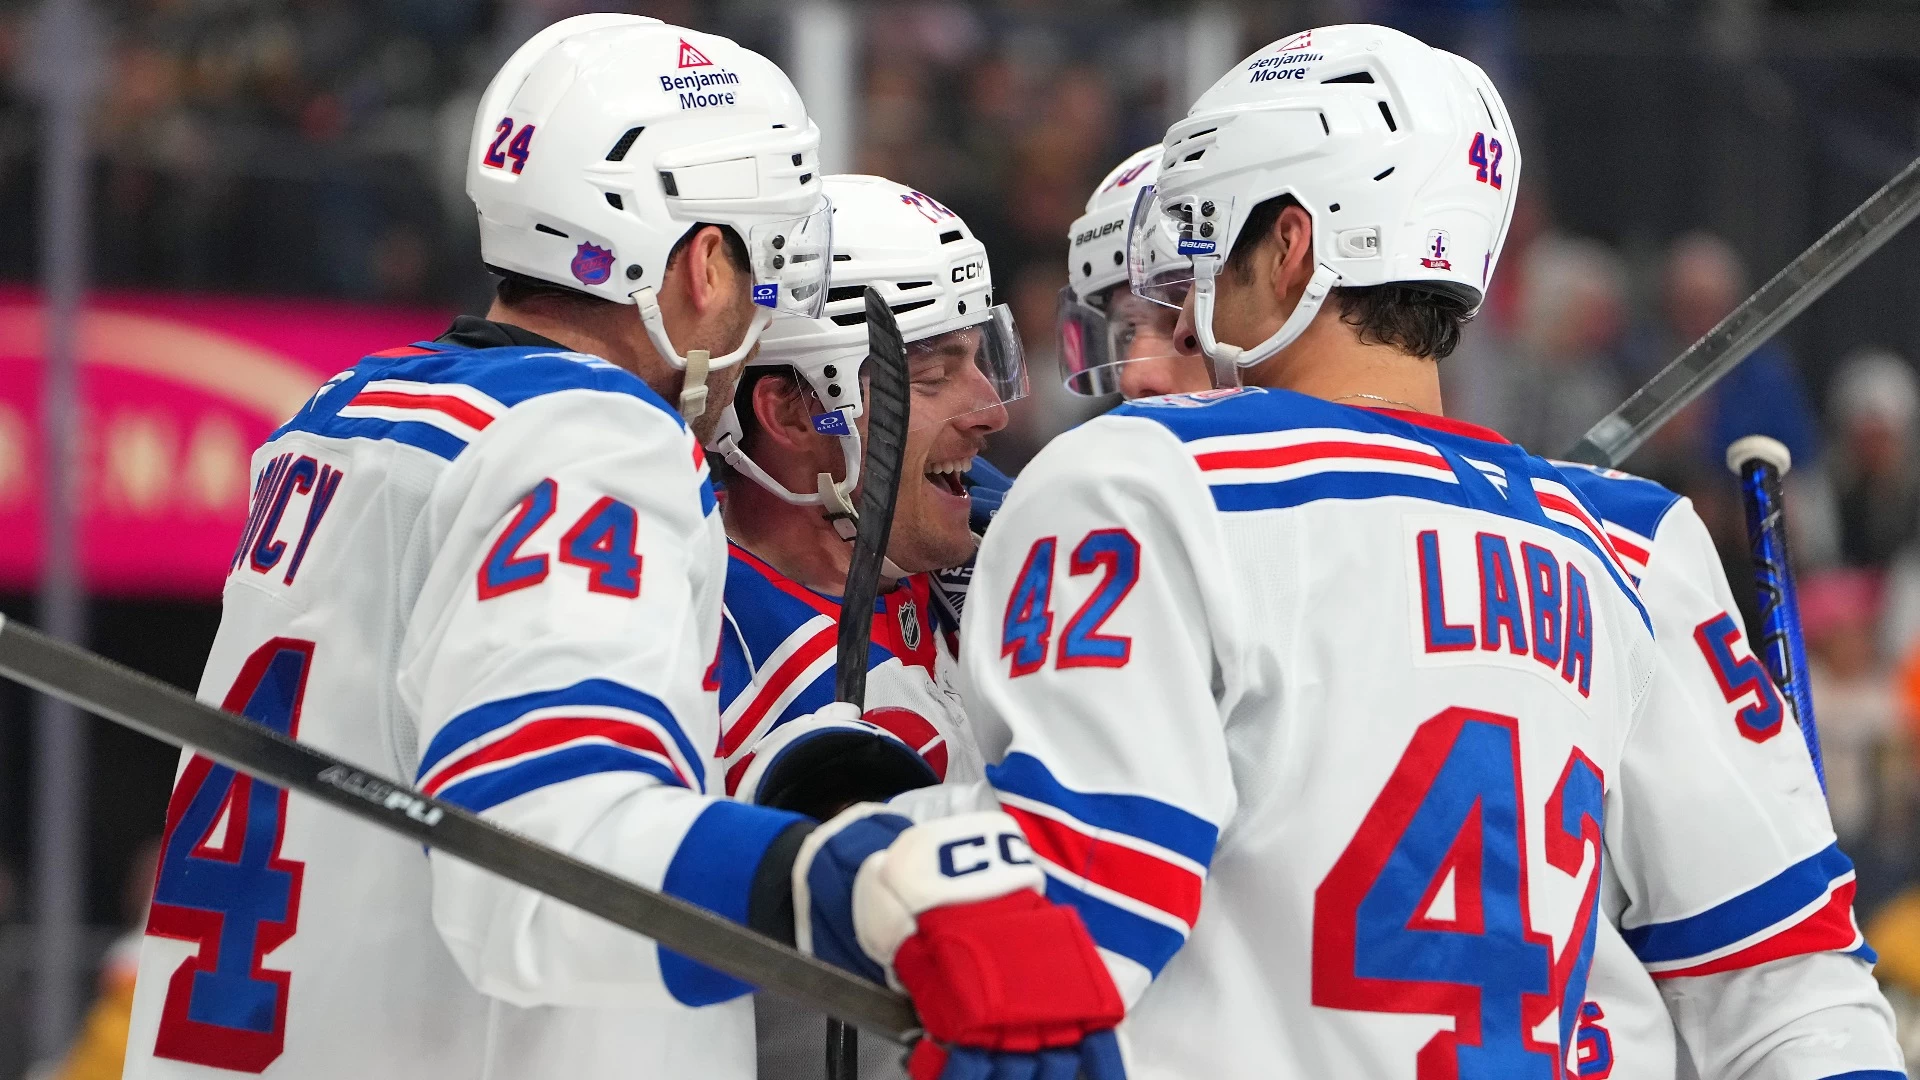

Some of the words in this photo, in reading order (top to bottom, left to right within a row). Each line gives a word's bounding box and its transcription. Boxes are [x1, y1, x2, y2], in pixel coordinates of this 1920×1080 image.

[1248, 52, 1324, 70] Benjamin
[660, 68, 739, 91] Benjamin
[1250, 68, 1305, 83] Moore
[679, 92, 734, 109] Moore
[483, 117, 535, 174] 24
[1469, 132, 1502, 190] 42
[1075, 219, 1124, 246] BAUER
[1180, 241, 1214, 249] BAUER
[952, 260, 984, 283] CCM
[817, 422, 843, 431] OAKLEY
[477, 477, 643, 602] 24
[1000, 528, 1141, 679] 42
[1416, 530, 1593, 699] LABA
[145, 637, 316, 1074] 4
[1311, 705, 1605, 1080] 42
